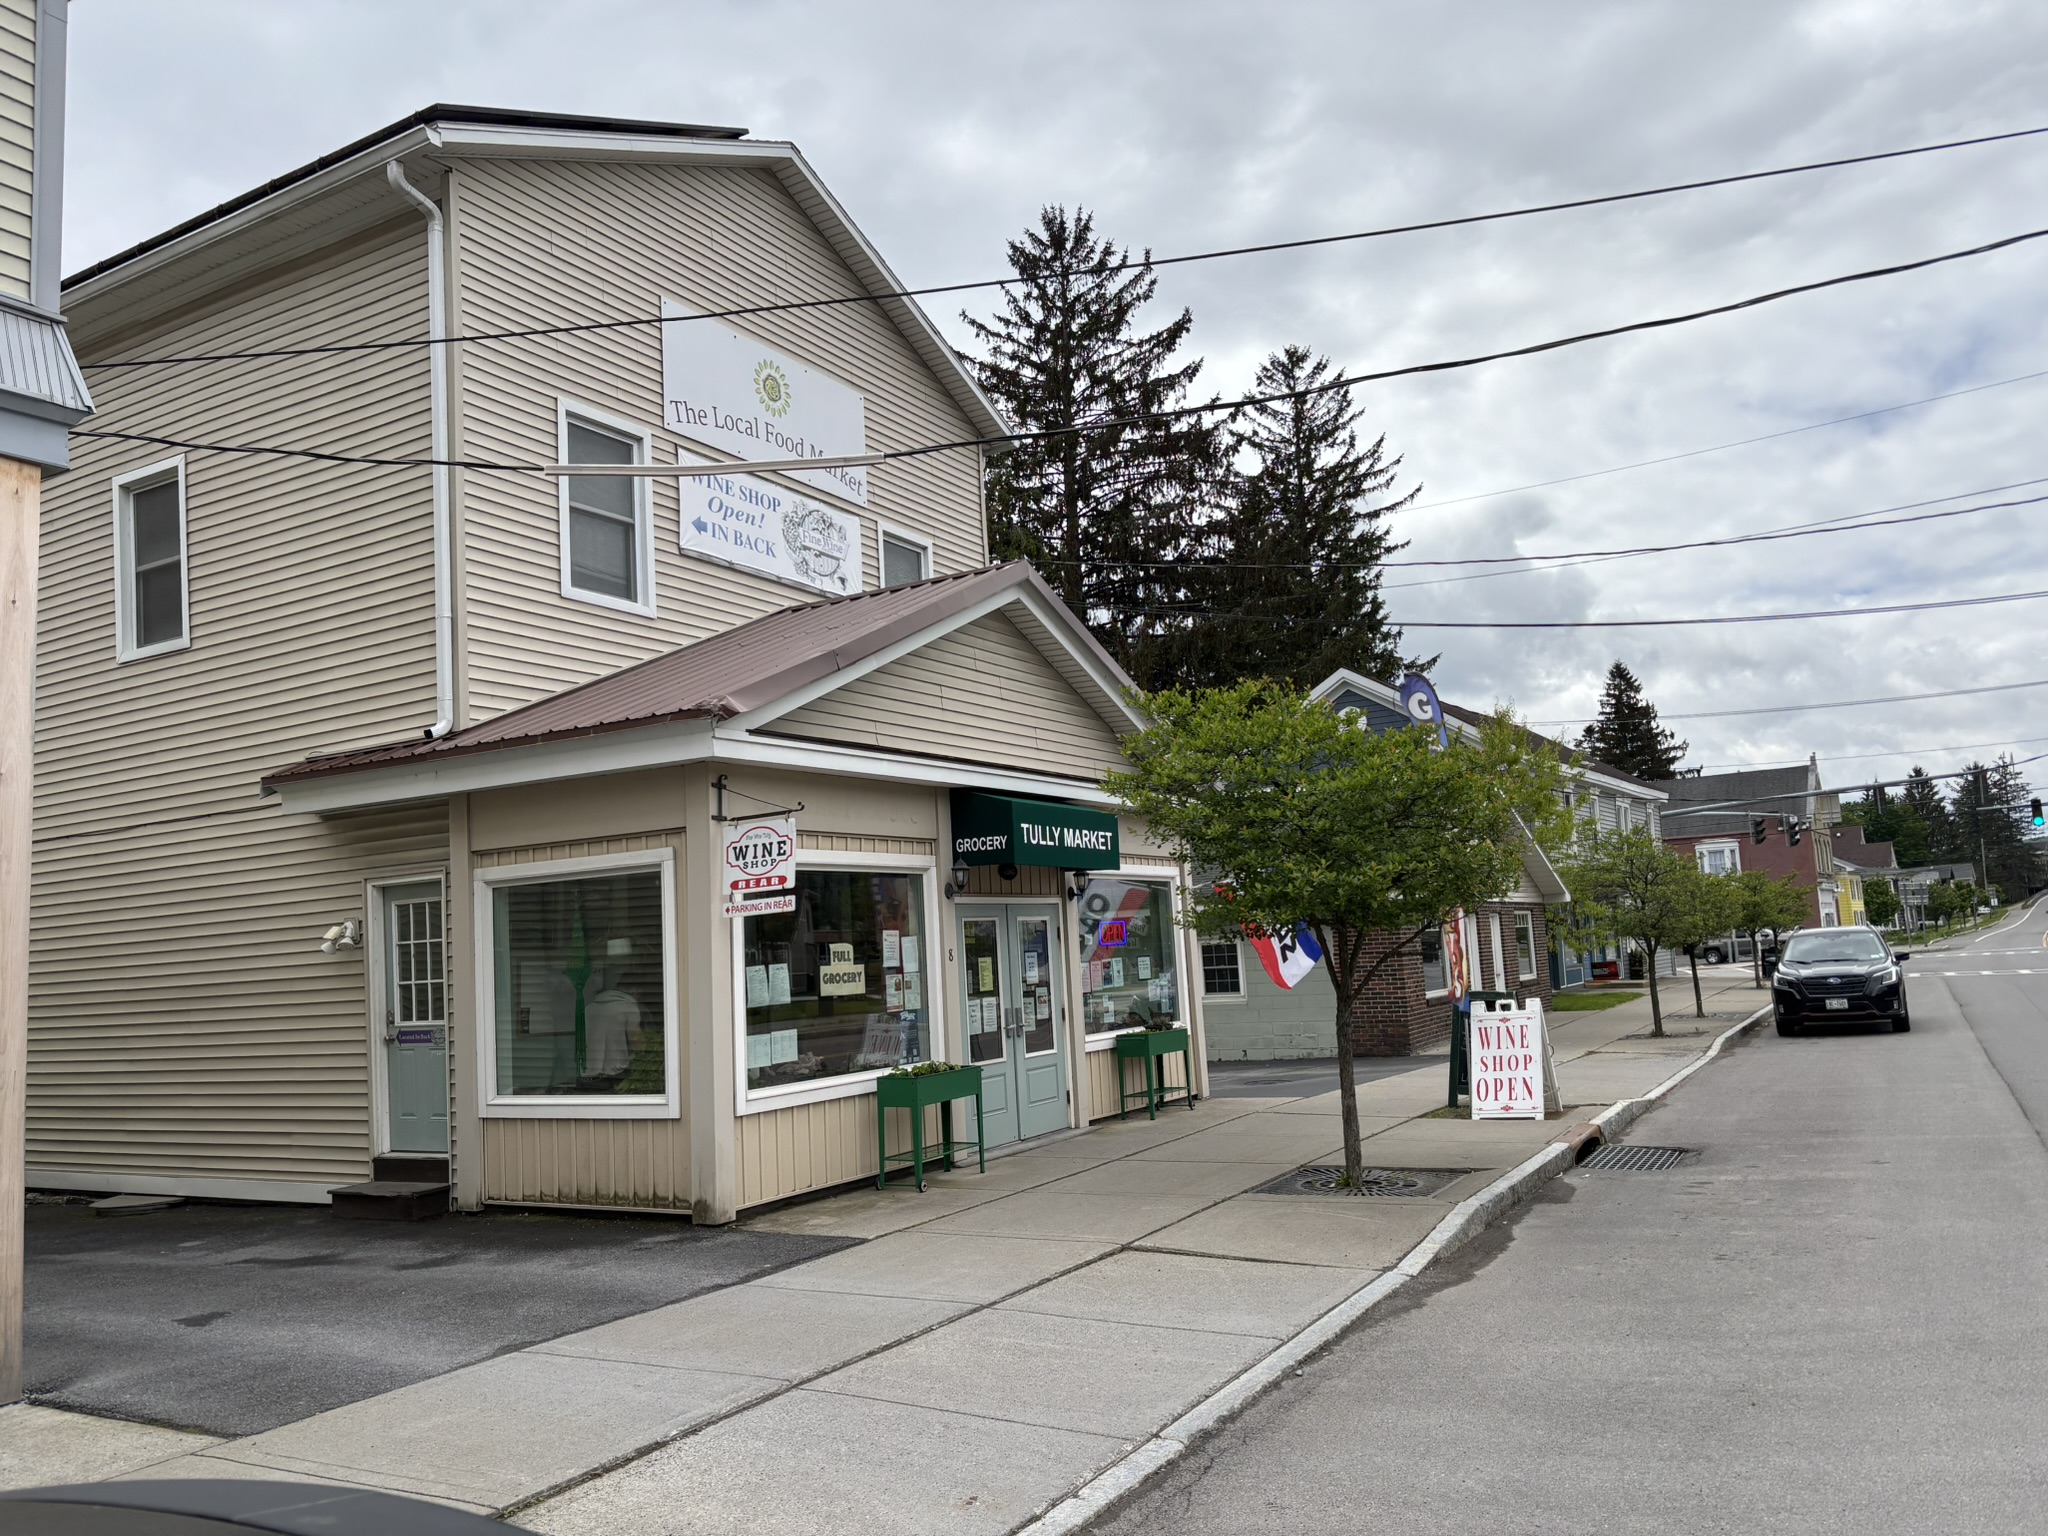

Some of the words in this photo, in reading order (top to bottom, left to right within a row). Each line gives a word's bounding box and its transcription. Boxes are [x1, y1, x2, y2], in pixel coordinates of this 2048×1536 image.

[669, 400, 708, 426] The
[712, 406, 760, 440] Local
[764, 422, 804, 458] Food
[739, 485, 781, 514] SHOP
[708, 496, 766, 530] Open!
[711, 522, 729, 543] IN
[733, 529, 777, 559] BACK
[956, 834, 1008, 853] GROCERY
[1020, 823, 1061, 847] TULLY
[1063, 827, 1113, 851] MARKET
[732, 839, 787, 862] WINE
[742, 858, 777, 870] SHOP
[738, 877, 780, 889] REAR
[731, 902, 763, 914] PARKING
[764, 902, 772, 911] IN
[773, 899, 793, 910] REAR
[1101, 924, 1125, 942] OPEN
[832, 950, 852, 963] FULL
[948, 948, 954, 962] 8
[822, 971, 863, 985] GROCERY
[1477, 1024, 1530, 1051] WINE
[1480, 1054, 1533, 1073] SHOP
[1476, 1076, 1534, 1102] OPEN
